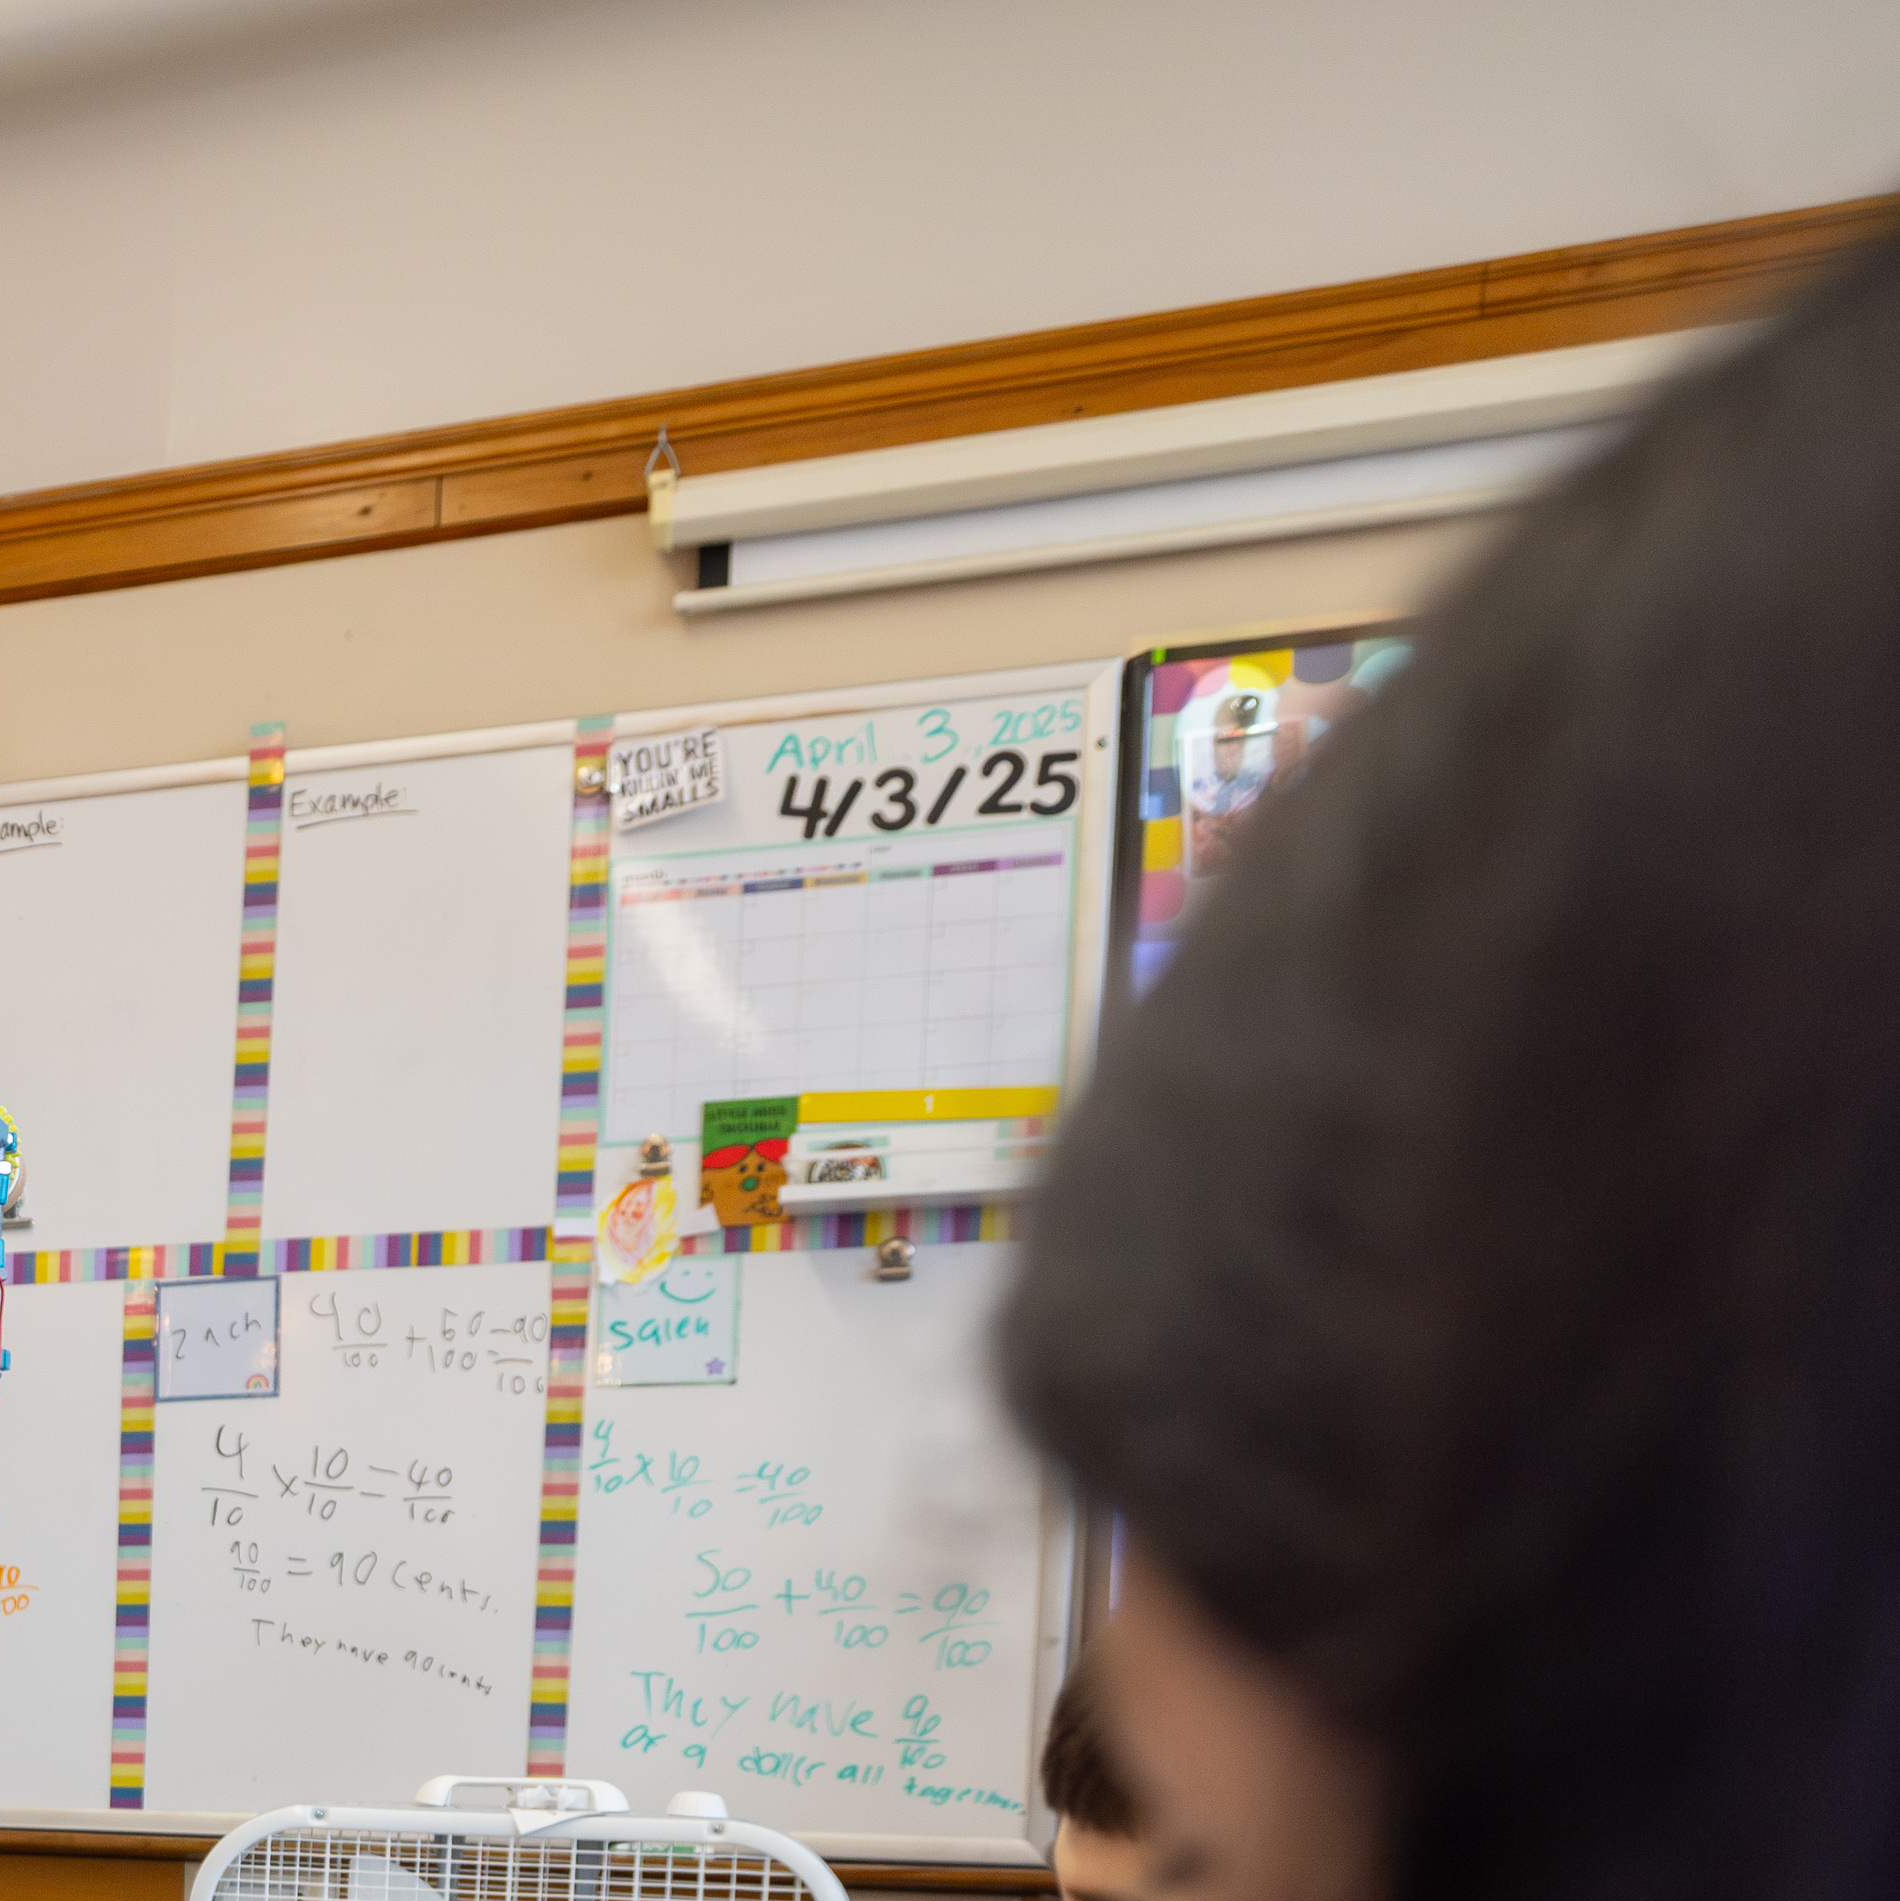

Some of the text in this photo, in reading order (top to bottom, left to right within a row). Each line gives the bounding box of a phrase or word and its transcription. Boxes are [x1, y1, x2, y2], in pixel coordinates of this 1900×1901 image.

[764, 698, 1085, 777] April 2025
[288, 783, 408, 820] Example:
[779, 748, 1083, 841] 4/3/25
[251, 1617, 328, 1654] They
